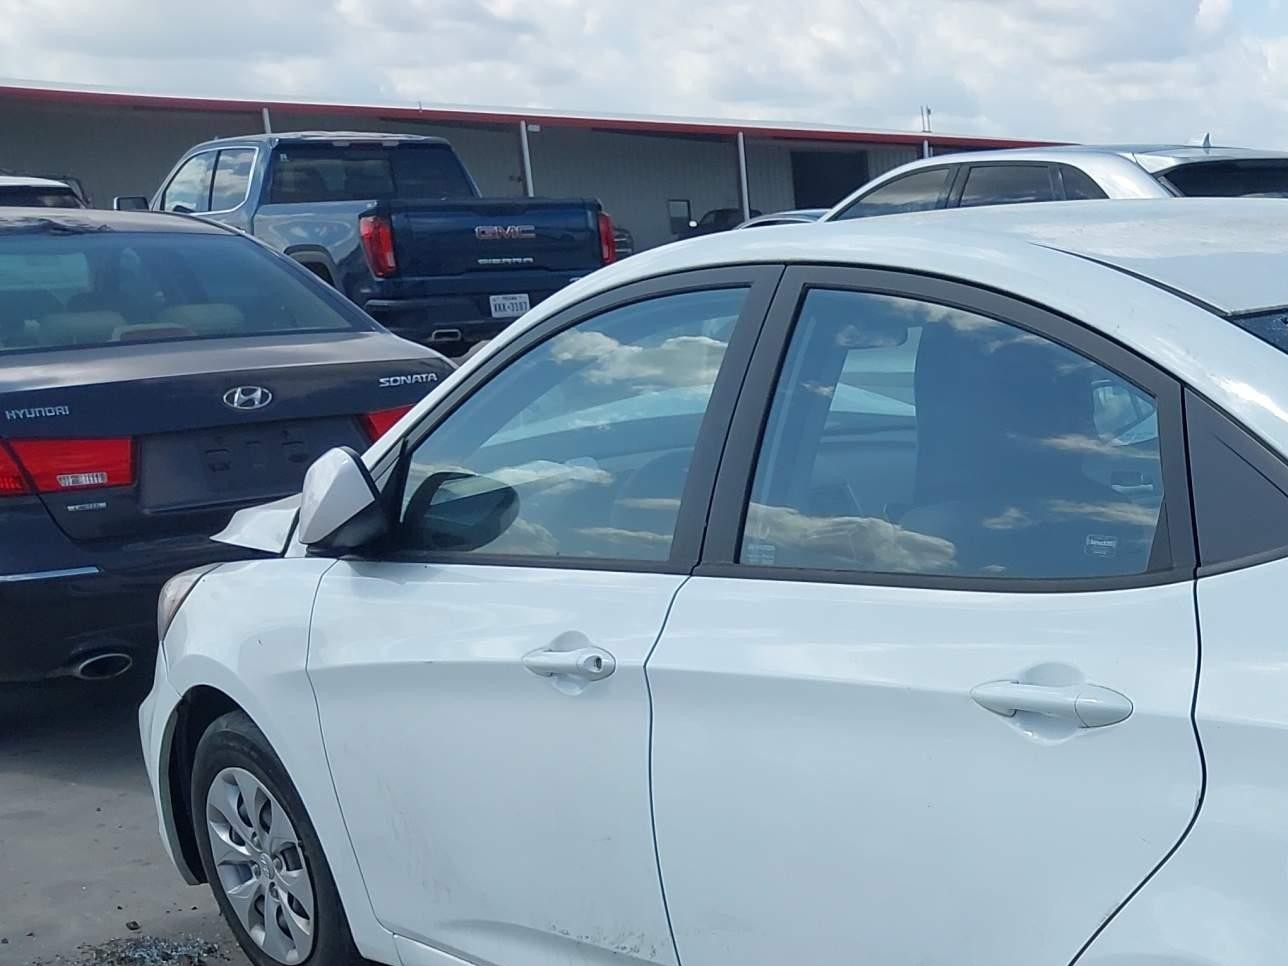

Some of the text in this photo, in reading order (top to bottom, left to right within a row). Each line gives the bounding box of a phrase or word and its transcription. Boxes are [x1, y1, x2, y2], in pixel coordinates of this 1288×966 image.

[474, 225, 536, 240] GMC
[379, 373, 438, 388] SONATA
[5, 405, 70, 420] HYUNDAI
